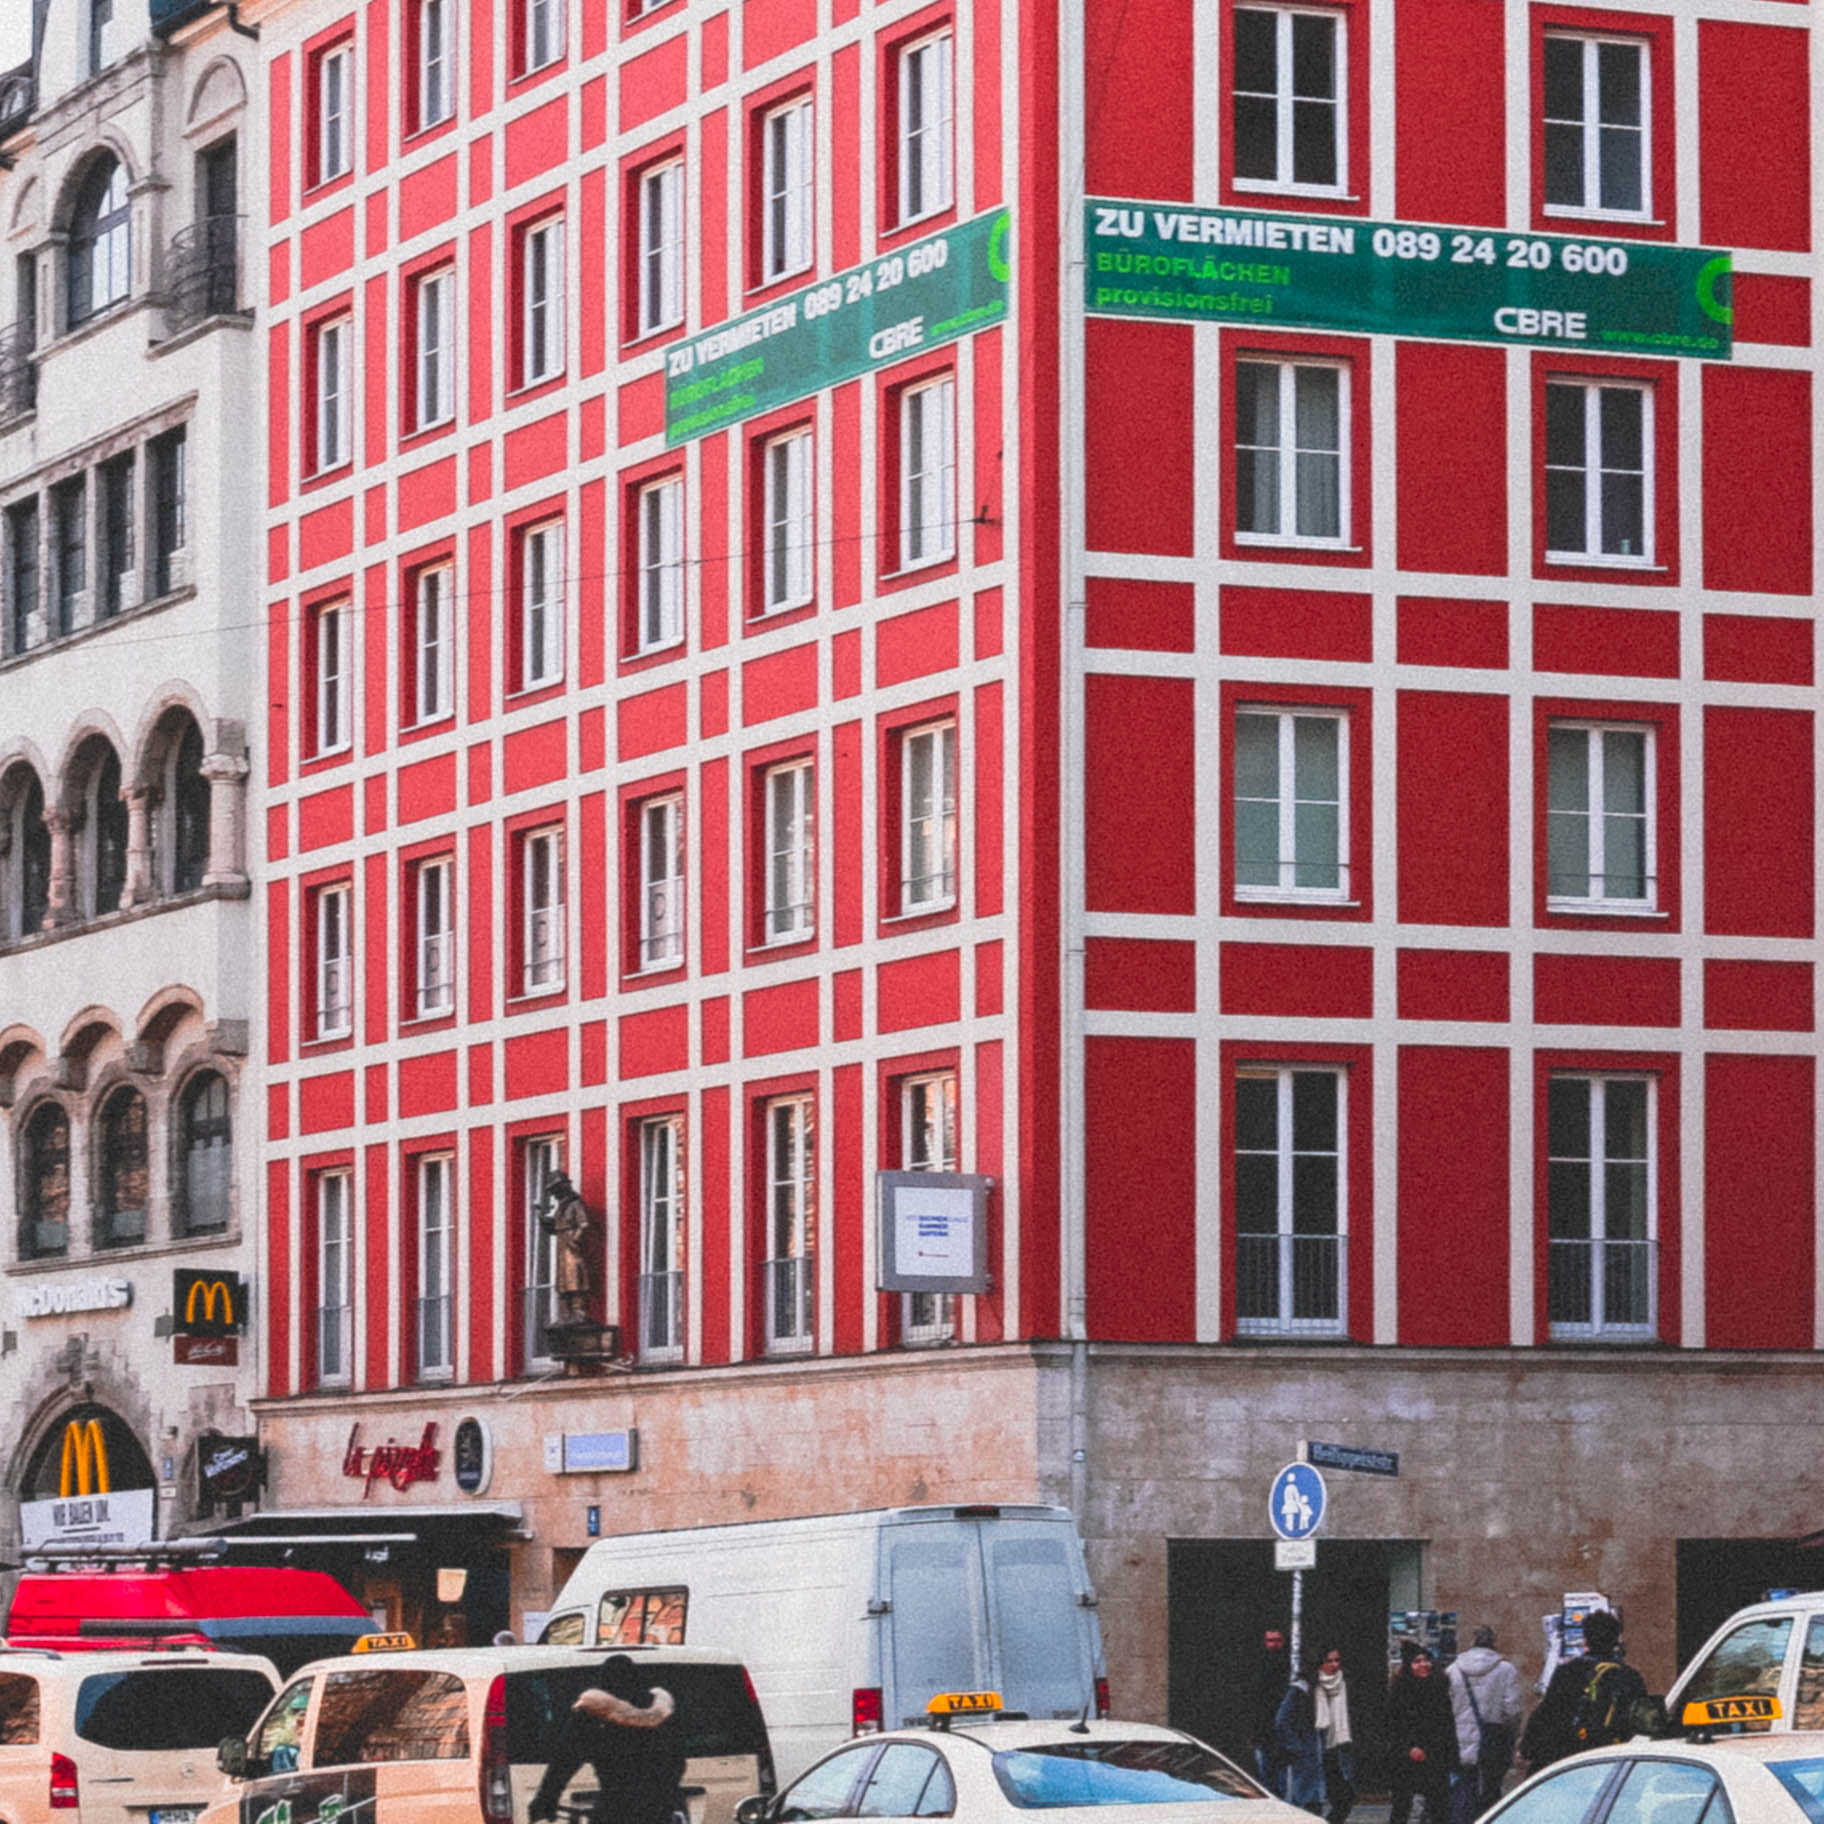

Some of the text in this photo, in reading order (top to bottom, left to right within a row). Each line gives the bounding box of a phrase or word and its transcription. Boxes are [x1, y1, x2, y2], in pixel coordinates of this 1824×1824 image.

[1094, 207, 1628, 276] ZU VERMIETEN 089 24 20 600
[1095, 247, 1292, 286] BÜROFLÄCHEN
[667, 238, 949, 378] ZU VERMIETEN 089 24 20 600
[1095, 285, 1274, 314] provisionsfrei
[868, 315, 924, 359] CBRE
[1493, 306, 1588, 340] CBRE
[368, 1635, 407, 1649] TAXI
[948, 1694, 995, 1710] TAXI
[1713, 1701, 1766, 1718] TAXI
